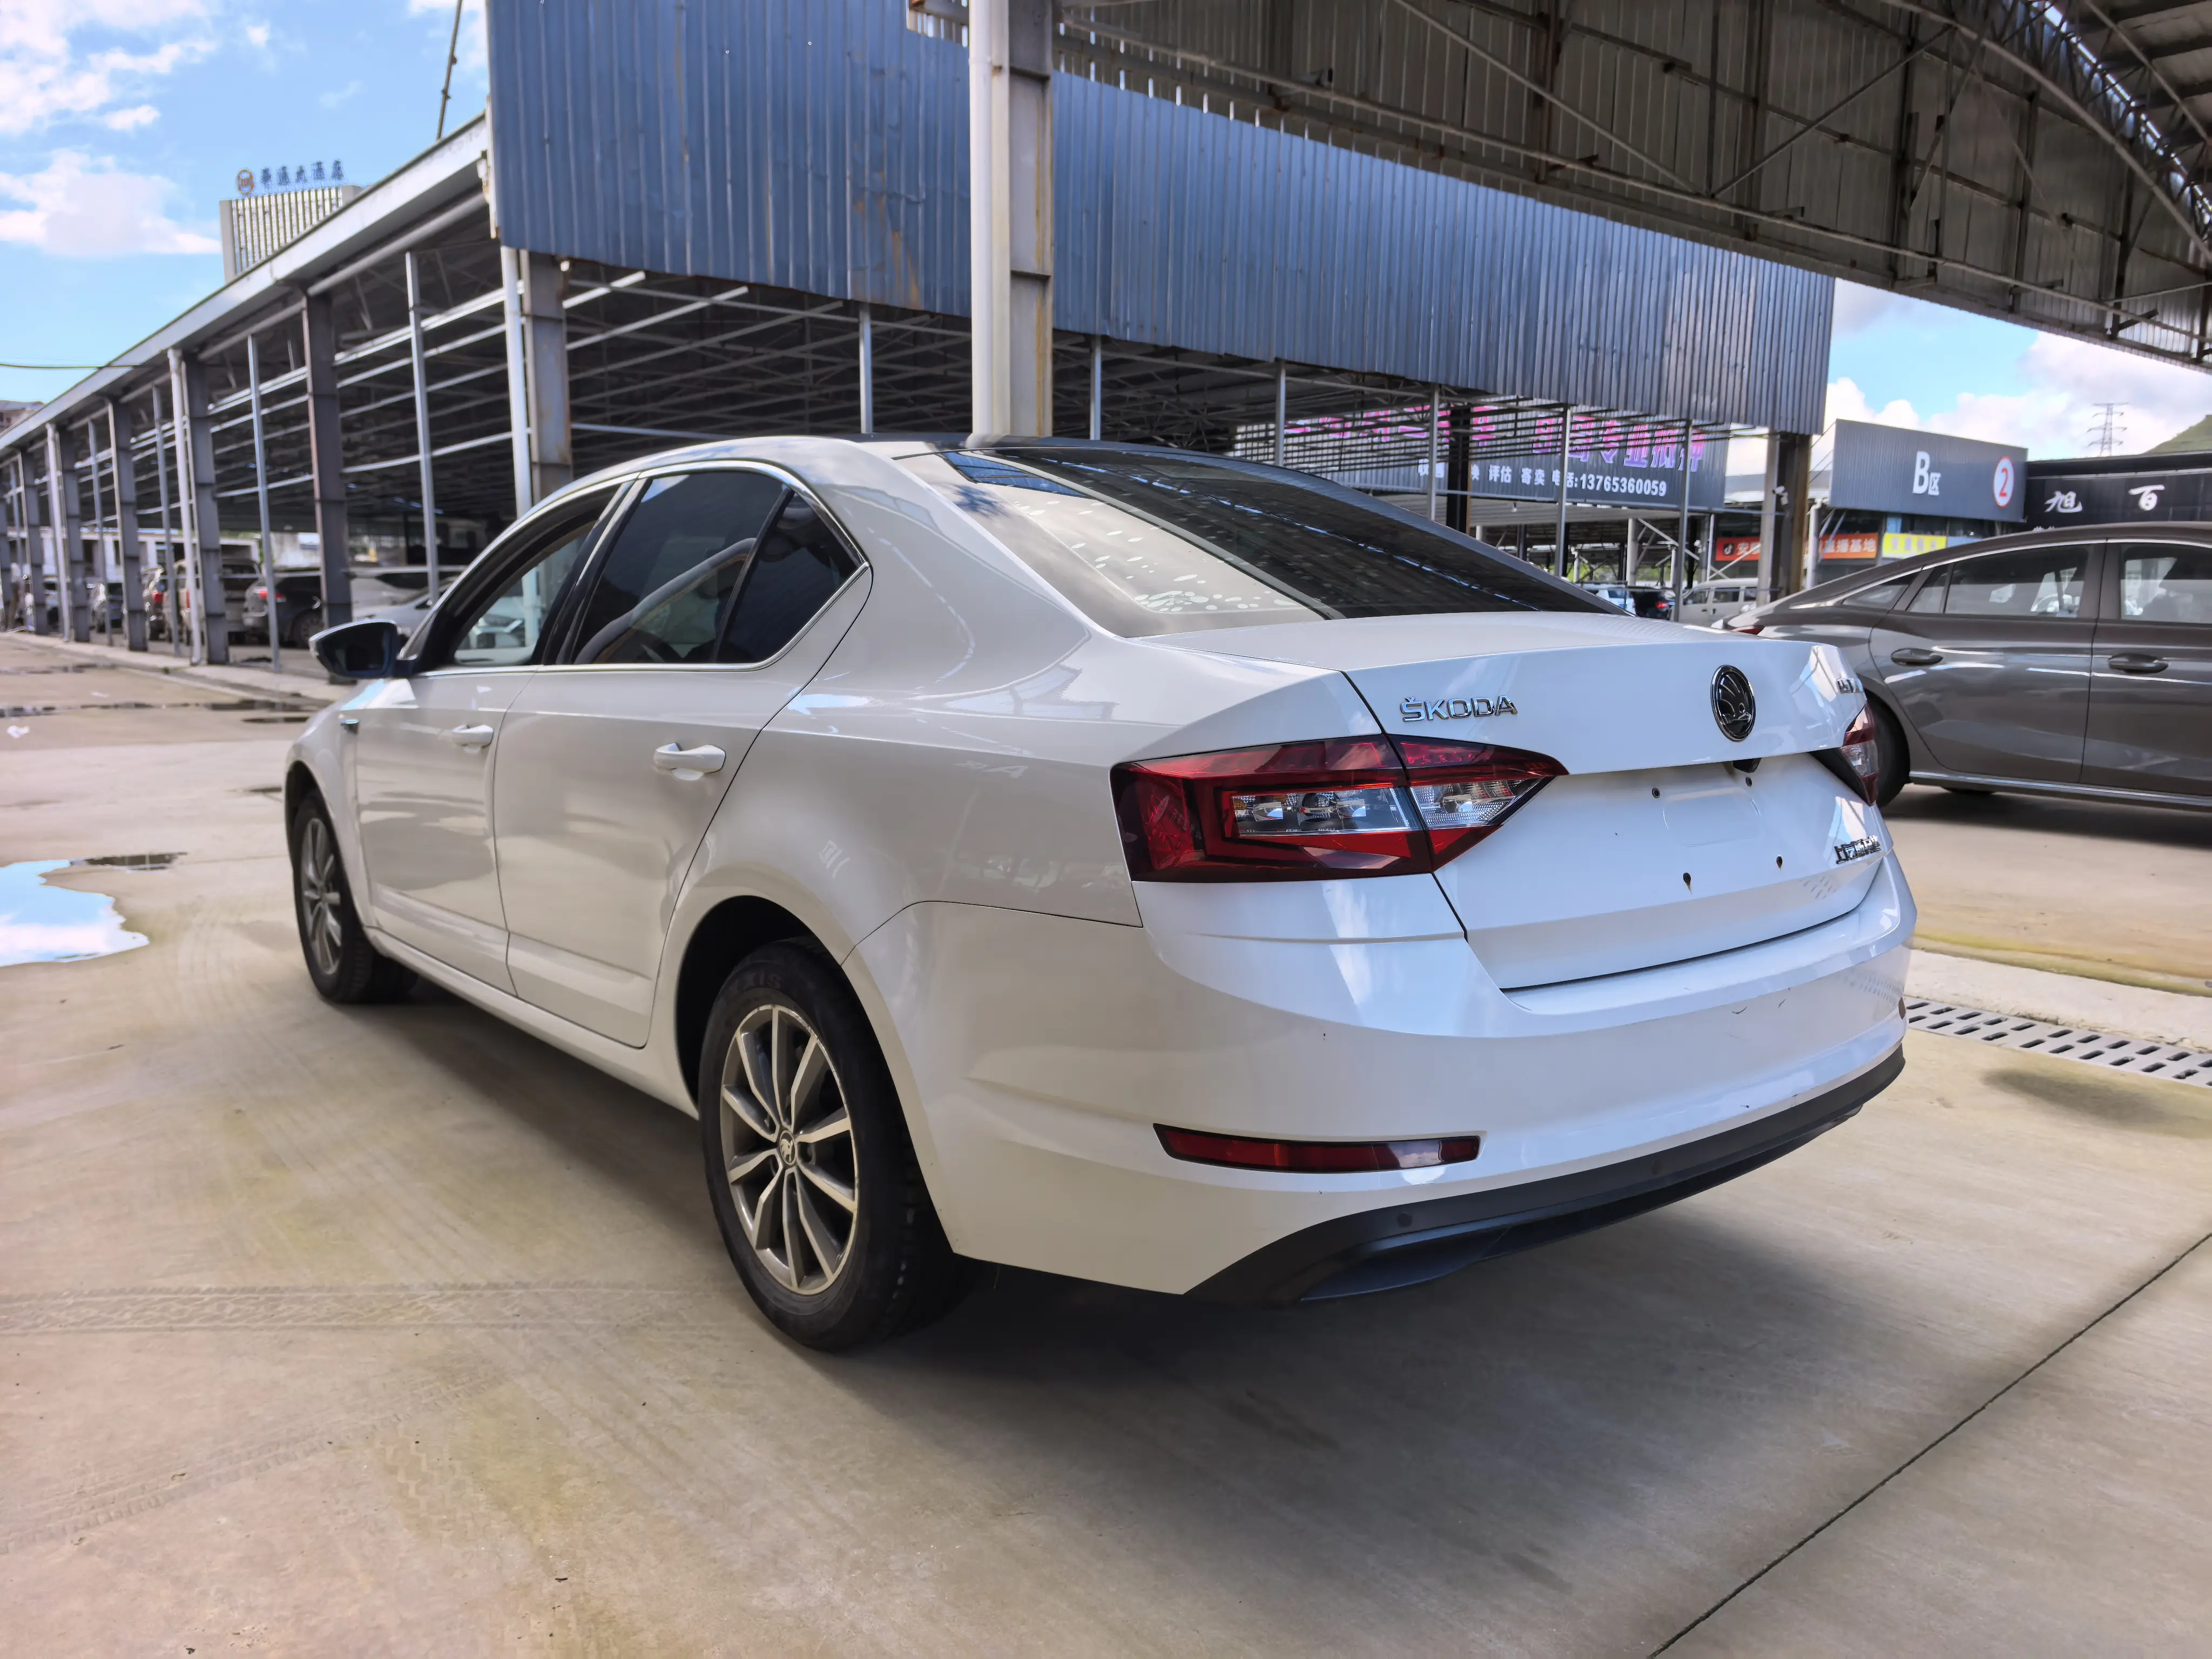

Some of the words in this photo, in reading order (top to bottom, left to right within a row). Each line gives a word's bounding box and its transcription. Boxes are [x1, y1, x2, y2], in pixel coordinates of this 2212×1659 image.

[1488, 464, 1512, 483] 评估
[1521, 467, 1545, 486] 寄卖
[1912, 450, 1941, 496] B区
[1999, 467, 2009, 497] 2
[1400, 694, 1518, 723] ŠKODA
